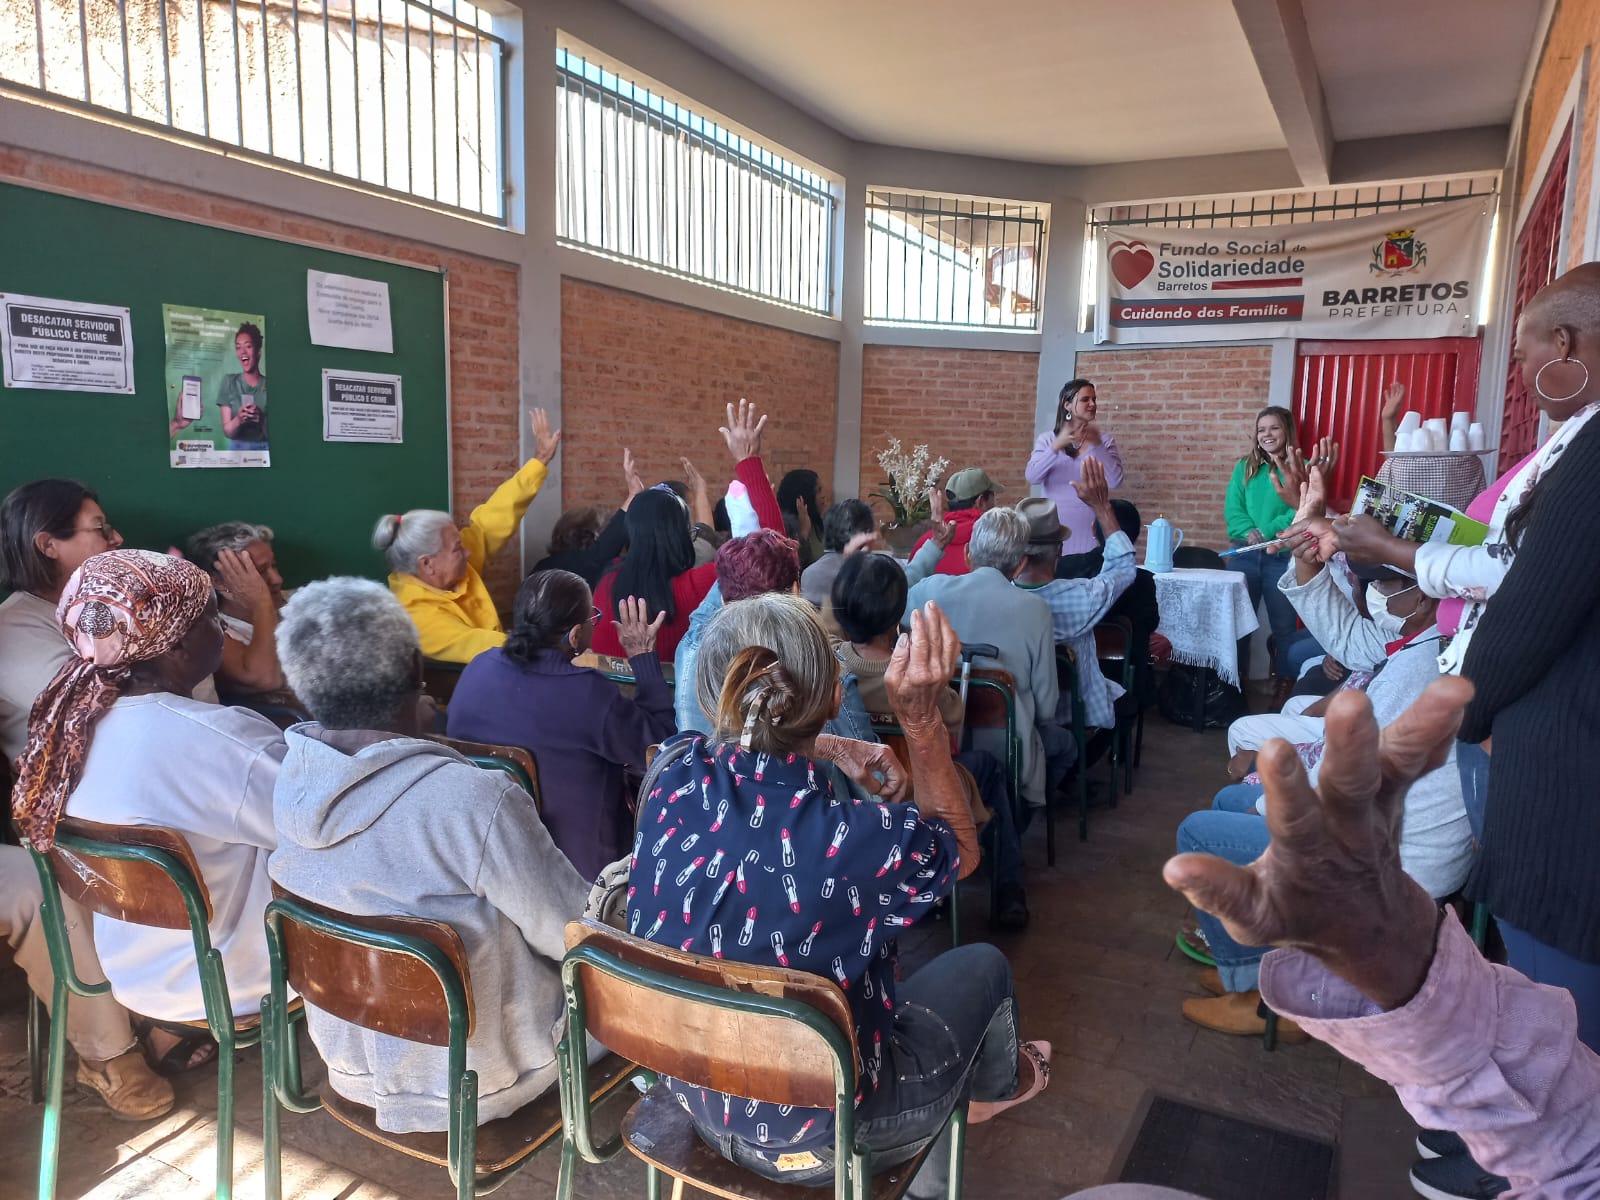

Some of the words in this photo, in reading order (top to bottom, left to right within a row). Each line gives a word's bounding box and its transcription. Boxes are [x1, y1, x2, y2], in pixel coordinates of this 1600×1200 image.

[1159, 242, 1220, 257] Fundo
[1225, 239, 1286, 256] Social
[1292, 244, 1307, 254] de
[1158, 256, 1305, 279] Solidariedade
[1157, 281, 1208, 292] Barretos
[1322, 281, 1469, 306] BARRETOS
[1120, 306, 1192, 321] Cuidando
[1197, 306, 1224, 319] das
[1229, 304, 1288, 317] Família
[1329, 302, 1458, 319] PREFEITURA
[21, 313, 73, 327] DESACATAR
[75, 319, 115, 332] SERVIDOR
[32, 325, 71, 340] PÚBLICO
[81, 332, 108, 343] CRIME
[335, 383, 367, 393] DESACATAR
[367, 386, 392, 395] SERVIDOR
[370, 395, 387, 404] CRIME
